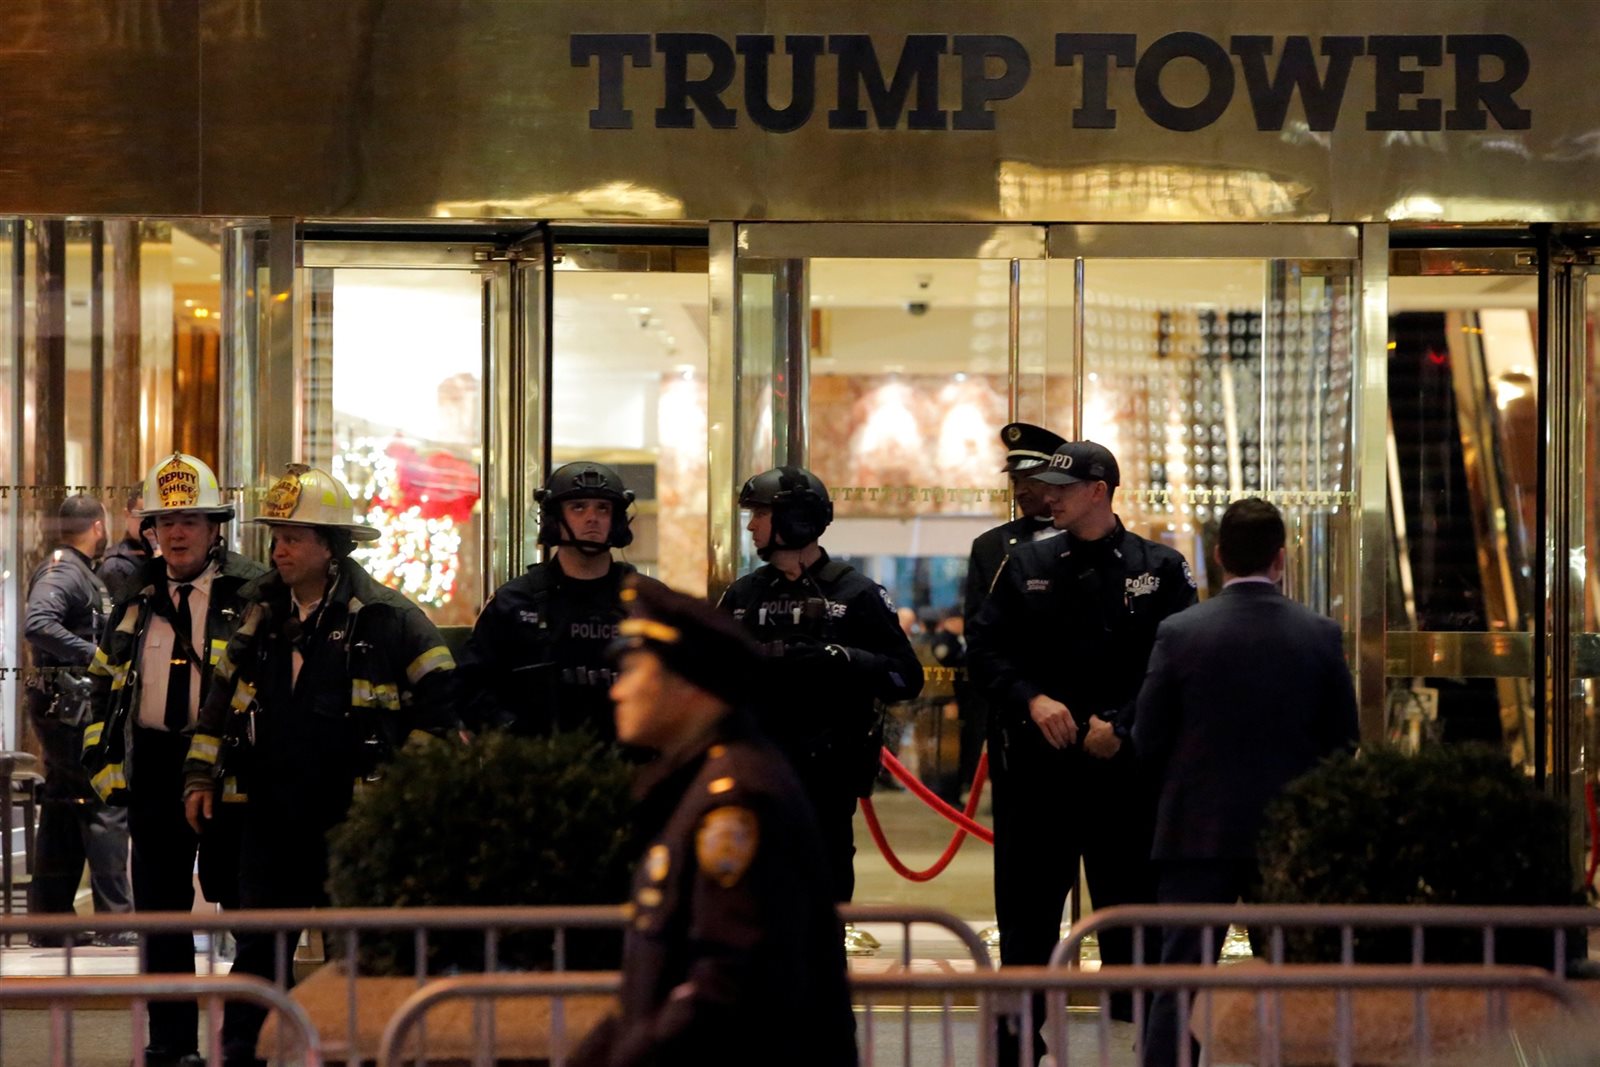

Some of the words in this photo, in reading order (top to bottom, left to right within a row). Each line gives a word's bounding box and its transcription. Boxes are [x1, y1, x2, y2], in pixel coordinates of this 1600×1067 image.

[570, 33, 1031, 132] TRUMP
[1055, 32, 1532, 131] TOWER
[158, 471, 196, 487] DEPUTY
[162, 483, 194, 496] CHIEF
[1125, 575, 1161, 589] POICE
[570, 623, 619, 640] POLICE
